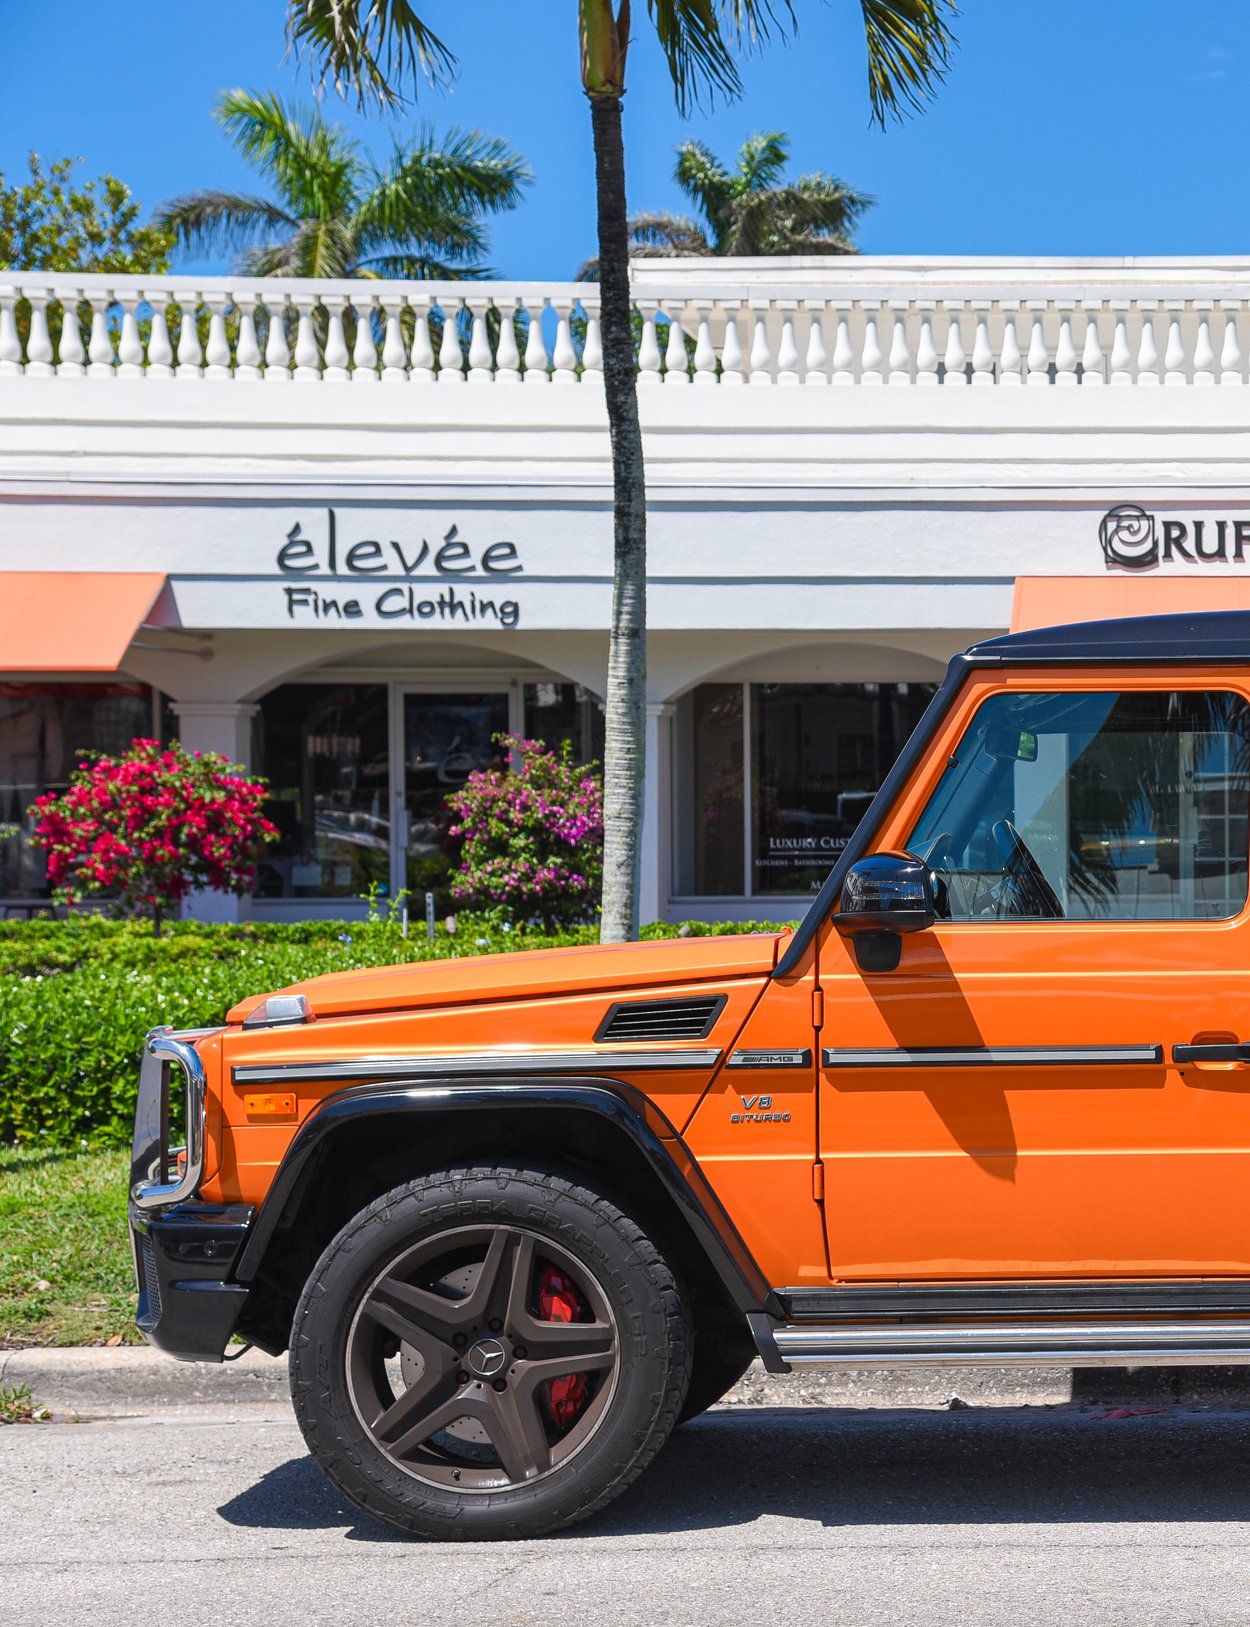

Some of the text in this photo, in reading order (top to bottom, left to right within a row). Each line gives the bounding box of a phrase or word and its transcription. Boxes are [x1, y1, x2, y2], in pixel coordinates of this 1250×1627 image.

[277, 507, 523, 574] élevée
[283, 585, 519, 629] Fine Clothing
[741, 1096, 772, 1108] V8
